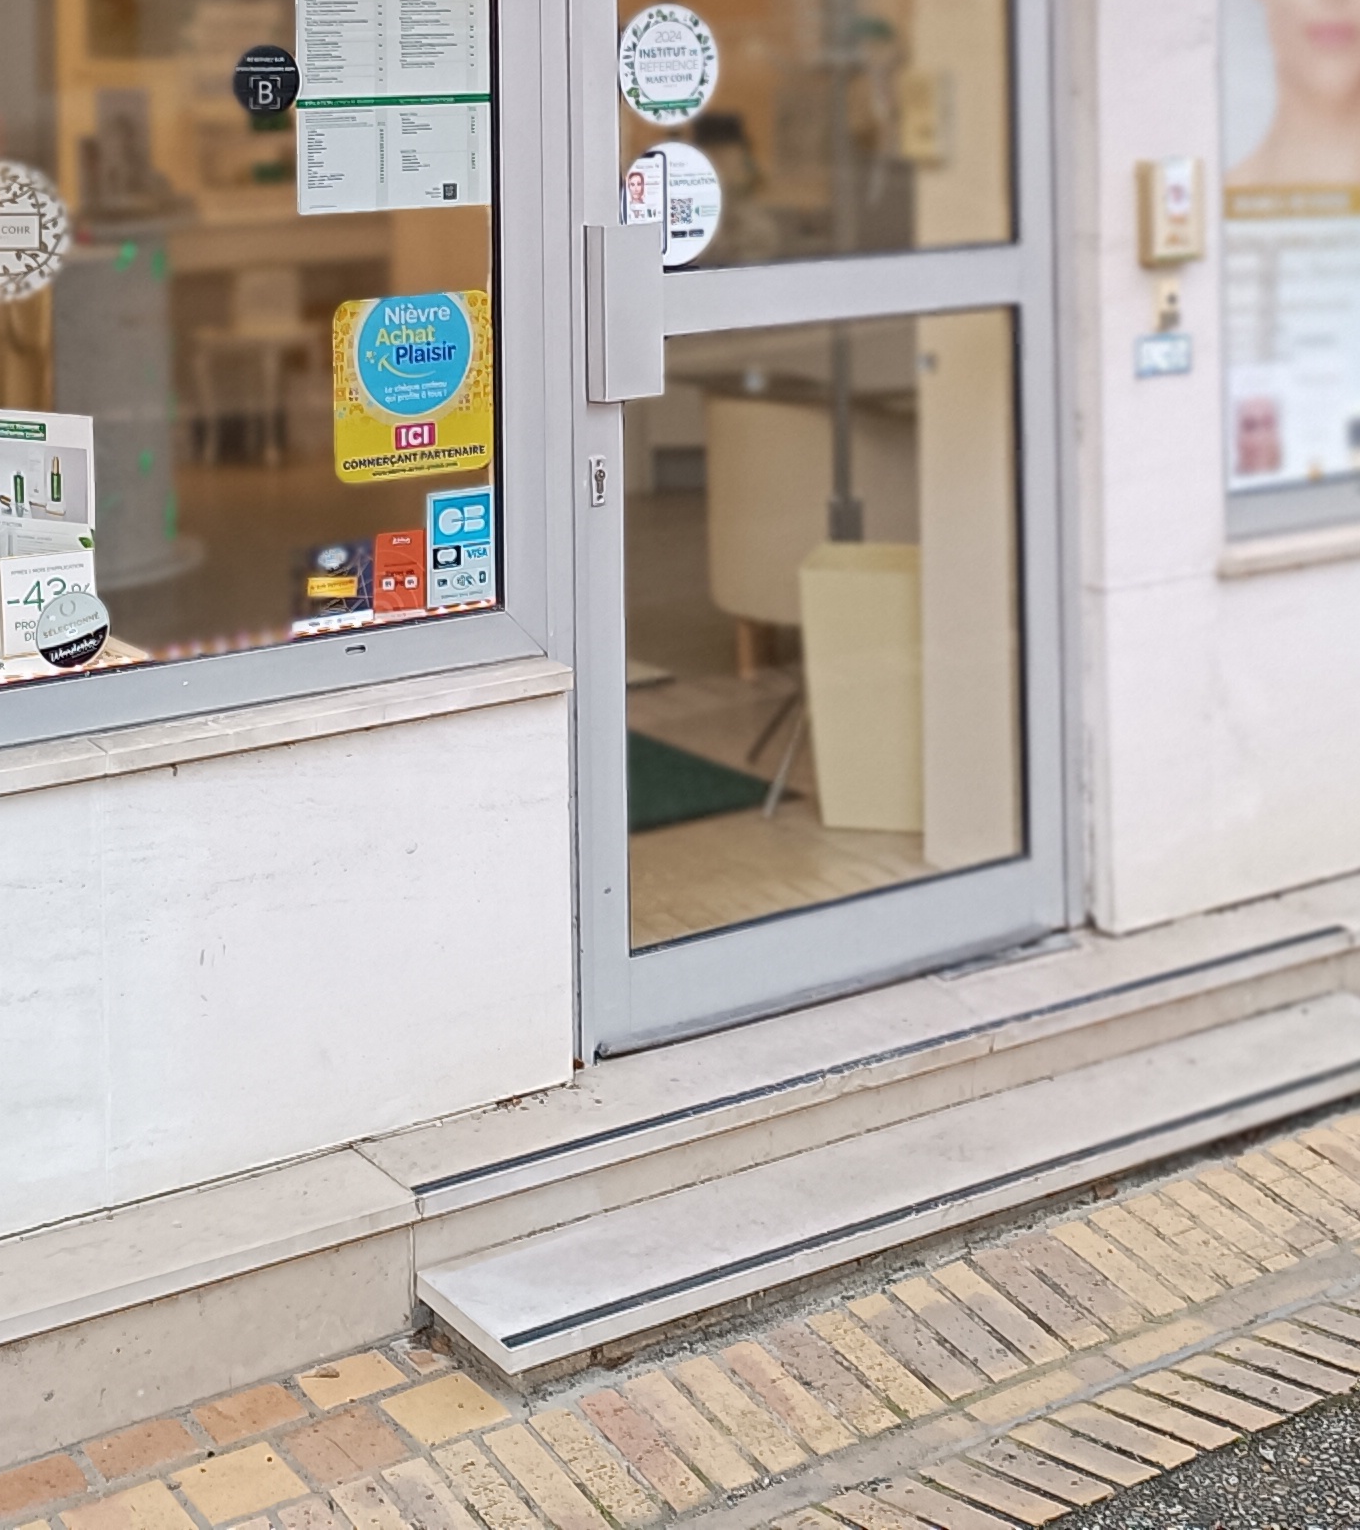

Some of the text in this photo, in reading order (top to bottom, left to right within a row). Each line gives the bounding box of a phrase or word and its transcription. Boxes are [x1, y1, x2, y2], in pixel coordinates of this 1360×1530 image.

[655, 30, 682, 43] 2024
[639, 46, 687, 59] INSTITUT
[645, 73, 694, 84] MARY COHR
[258, 80, 274, 105] B
[1, 225, 31, 235] COHR
[384, 303, 451, 326] Nièvre
[375, 325, 436, 348] Achat
[395, 341, 457, 366] Plaisir
[400, 425, 430, 447] ICI
[343, 453, 418, 471] COMMERÇANT
[420, 444, 486, 461] PARTENAIRE
[438, 504, 486, 536] CB
[466, 547, 489, 560] VISA
[42, 611, 100, 639] SÉLECTIONNÉ
